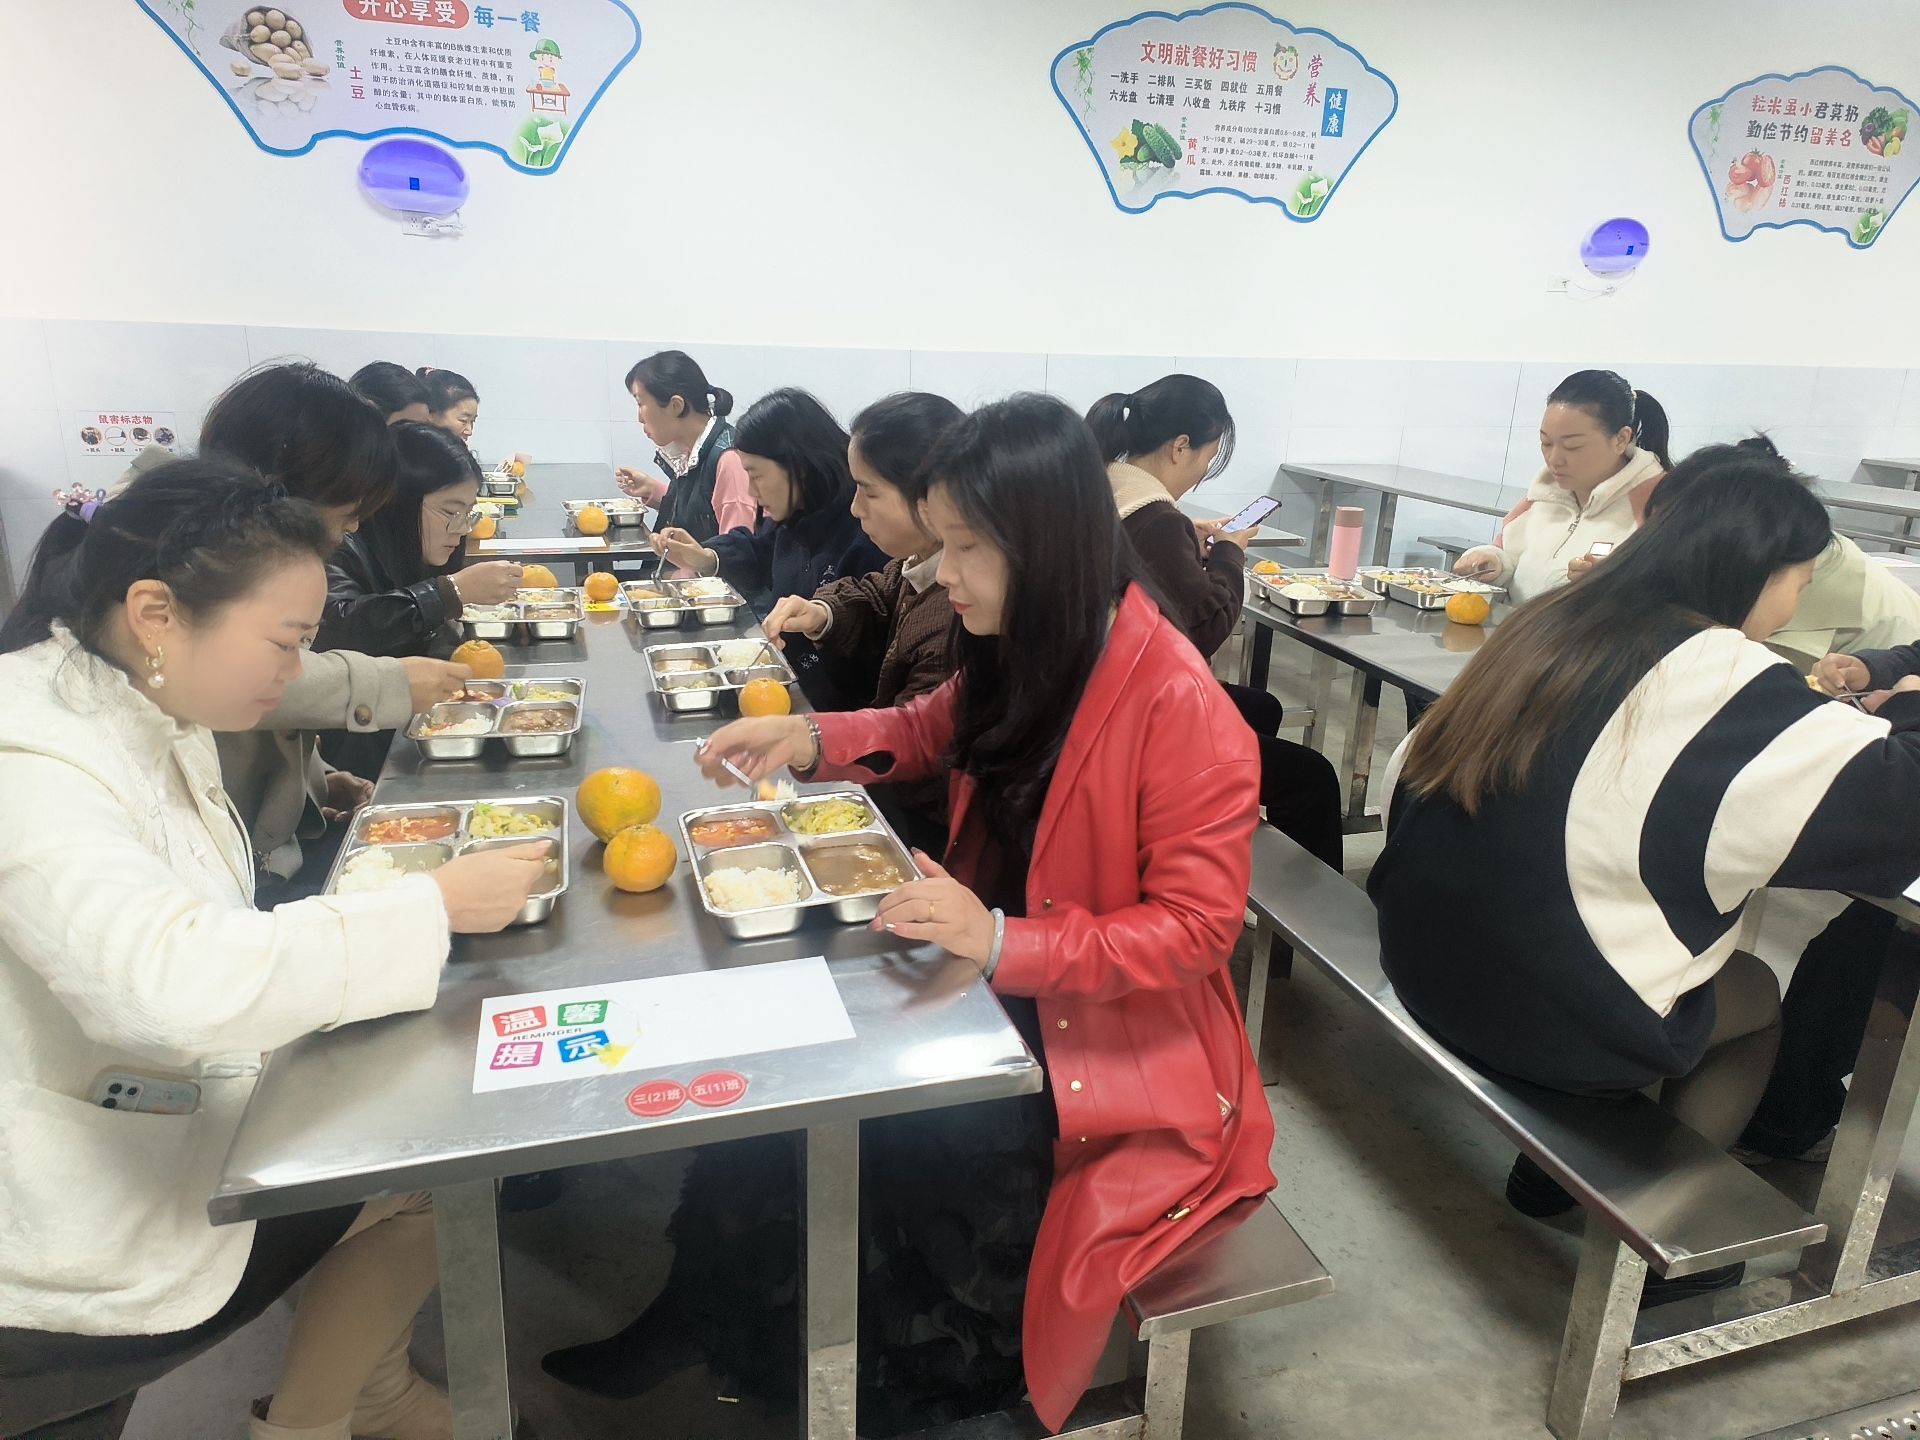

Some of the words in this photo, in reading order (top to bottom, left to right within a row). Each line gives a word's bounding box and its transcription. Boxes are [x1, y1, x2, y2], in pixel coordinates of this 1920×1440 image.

[360, 0, 456, 24] 开心享受
[474, 5, 541, 33] 每一餐
[1140, 40, 1258, 73] 文明就餐好习惯
[350, 66, 365, 100] 土豆
[1110, 71, 1139, 85] 一洗手
[1147, 74, 1176, 88] 二排队
[1184, 77, 1212, 91] 三买饭
[1221, 81, 1248, 94] 四就位
[1256, 83, 1283, 97] 五用餐
[1109, 89, 1138, 104] 六光盘
[1146, 92, 1175, 107] 七清理
[1183, 95, 1211, 110] 八收盘
[1219, 98, 1246, 112] 九秩序
[1255, 102, 1282, 115] 十习惯
[1326, 93, 1343, 134] 健康
[1752, 94, 1859, 122] 粒米虽小君莫扔
[1746, 119, 1852, 147] 勤俭节约留美名
[1187, 138, 1198, 166] 黄瓜
[98, 414, 153, 425] 鼠害标志物
[633, 1087, 681, 1106] 三(2)班
[695, 1078, 741, 1097] 五(1)班
